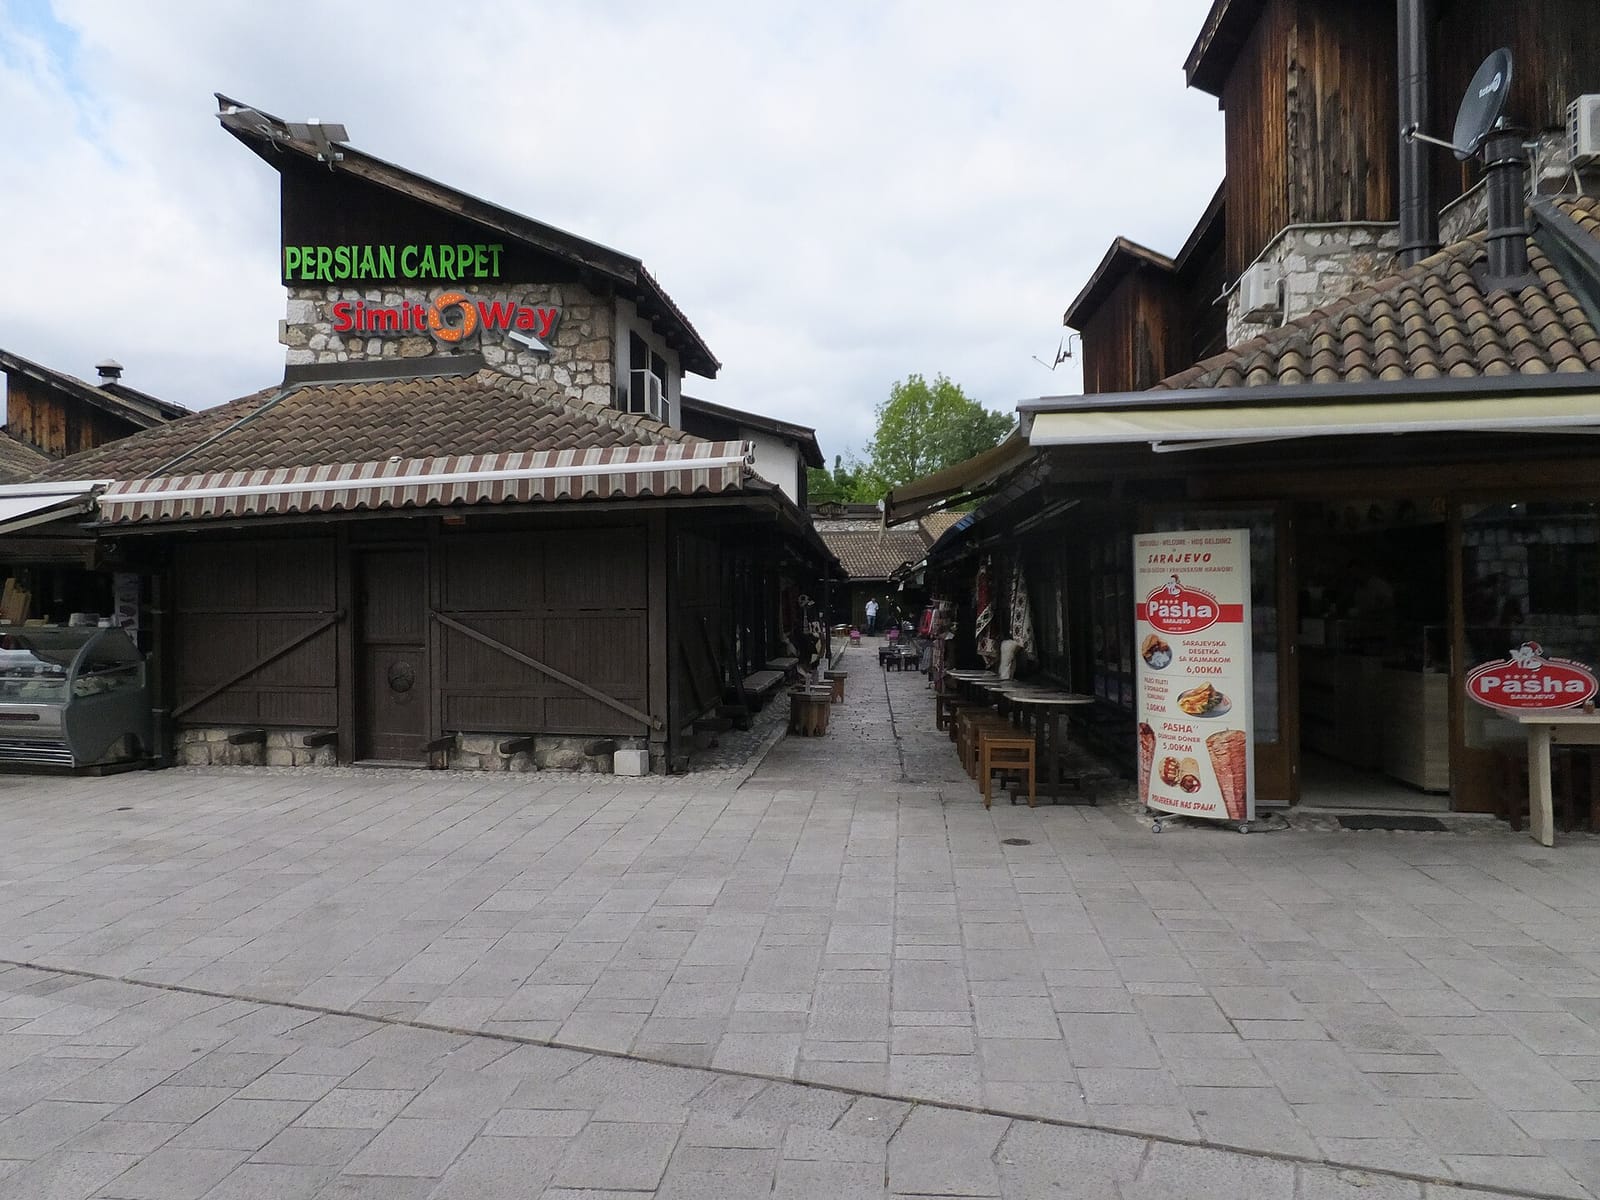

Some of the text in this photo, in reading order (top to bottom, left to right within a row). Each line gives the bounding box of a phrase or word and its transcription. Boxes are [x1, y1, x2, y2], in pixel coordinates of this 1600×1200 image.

[285, 244, 503, 282] PERSIAN CARPET
[333, 301, 426, 331] Simit
[478, 301, 557, 337] Way
[1148, 552, 1212, 564] SARAJEVO
[1149, 601, 1213, 618] Pasha
[1186, 666, 1222, 675] 6,00KM
[1480, 676, 1585, 693] Pasha
[1163, 742, 1193, 752] 5,00KM
